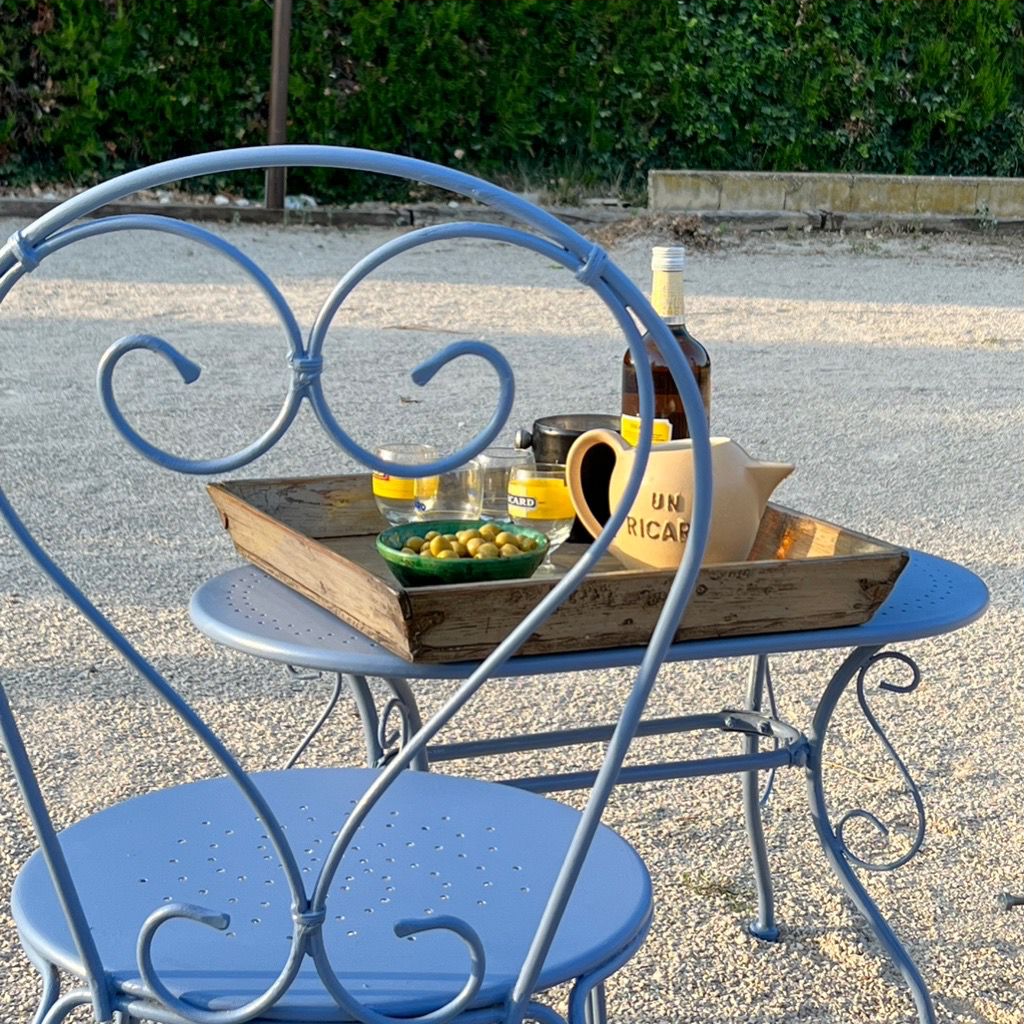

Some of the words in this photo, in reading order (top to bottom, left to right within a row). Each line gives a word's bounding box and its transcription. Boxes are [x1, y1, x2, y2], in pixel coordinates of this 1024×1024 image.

[507, 495, 535, 507] CARD
[651, 492, 684, 513] UN
[626, 516, 691, 544] RICAR
